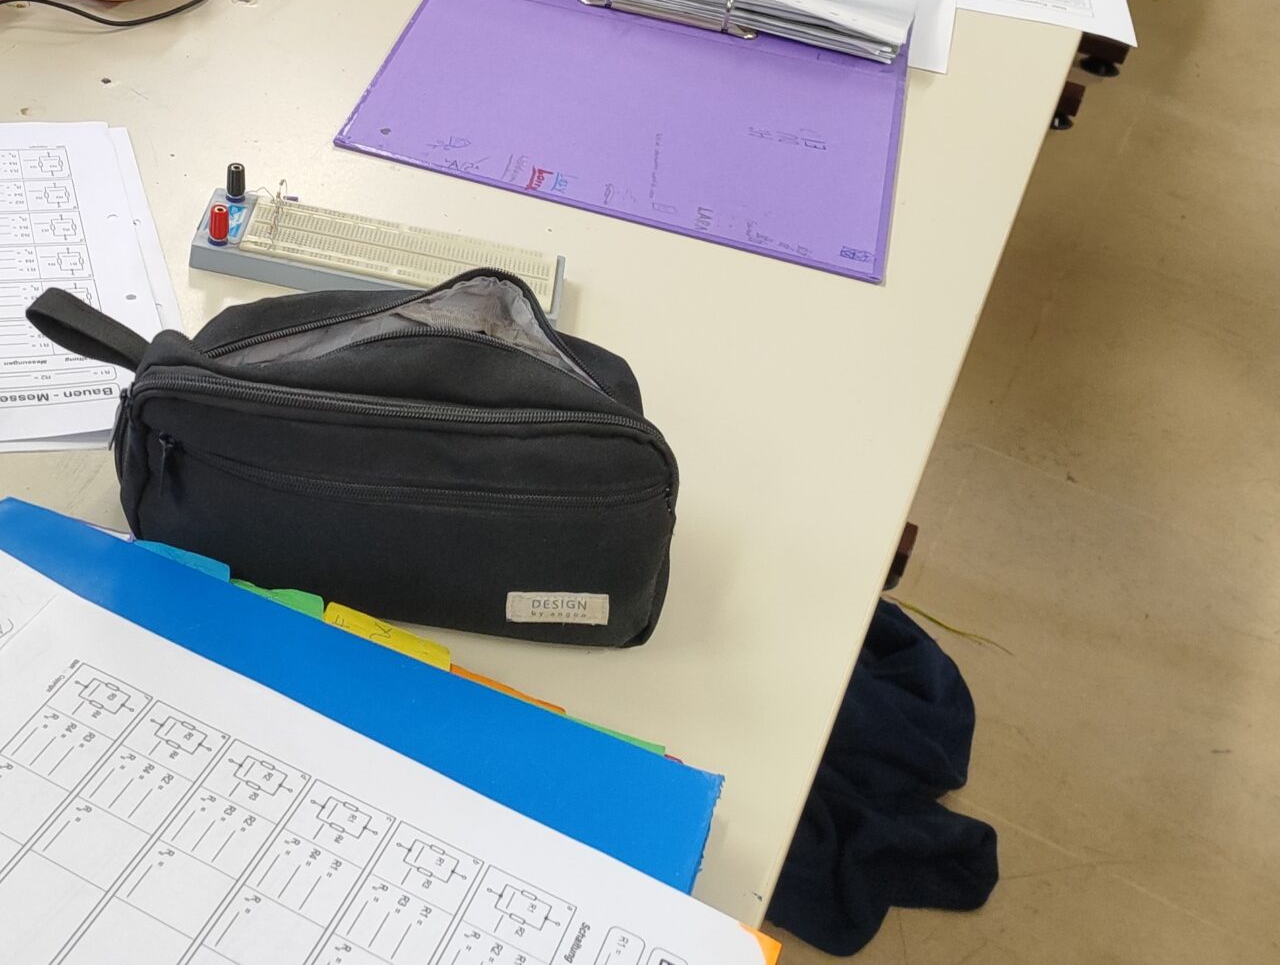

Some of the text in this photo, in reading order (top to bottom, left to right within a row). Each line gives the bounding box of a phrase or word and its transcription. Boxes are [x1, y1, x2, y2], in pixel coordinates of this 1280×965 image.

[63, 387, 113, 398] Bauen
[531, 599, 587, 611] DESIGN
[564, 921, 591, 964] Schaltung
[616, 935, 629, 949] R1
